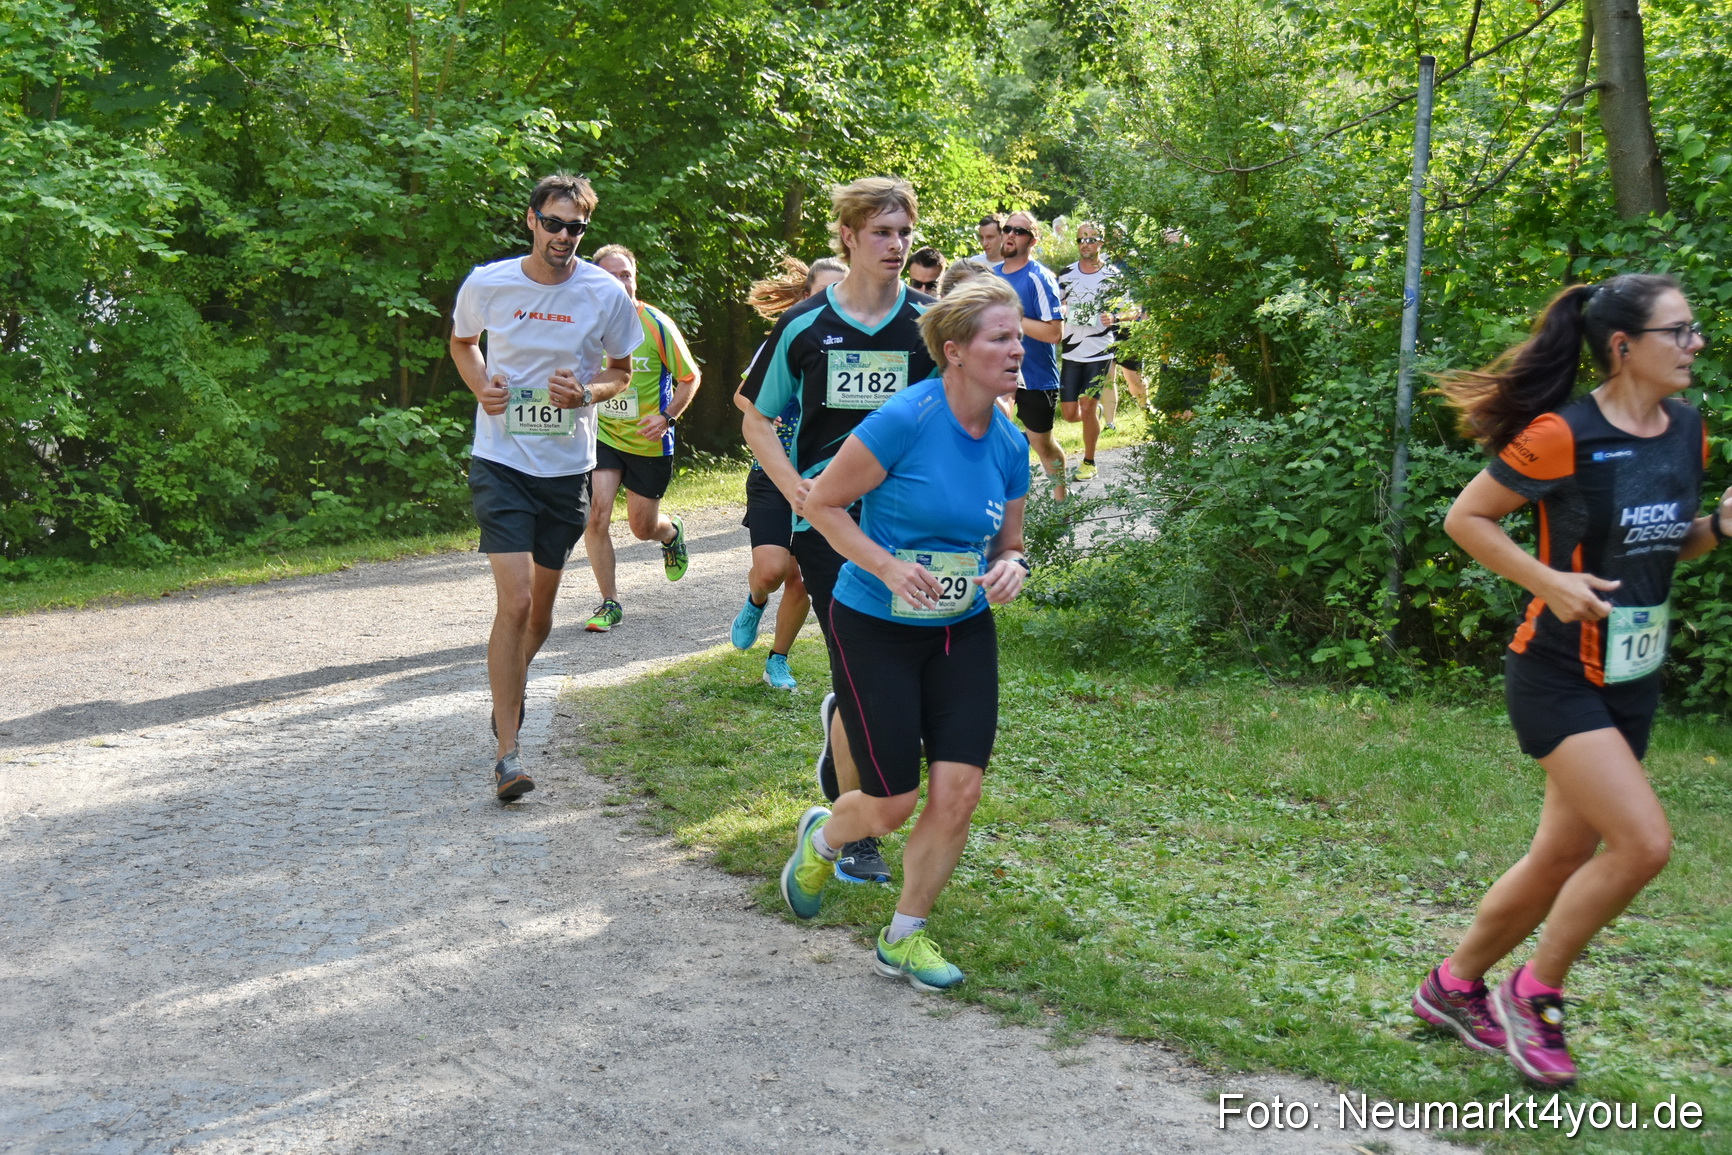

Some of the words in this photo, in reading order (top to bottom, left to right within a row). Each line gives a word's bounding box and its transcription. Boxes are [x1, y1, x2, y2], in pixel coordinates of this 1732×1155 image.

[529, 312, 575, 323] KLEBL
[837, 372, 896, 393] 2182
[515, 405, 562, 423] 1161
[604, 399, 628, 411] 330
[1620, 503, 1677, 526] HECK
[938, 577, 967, 599] 29
